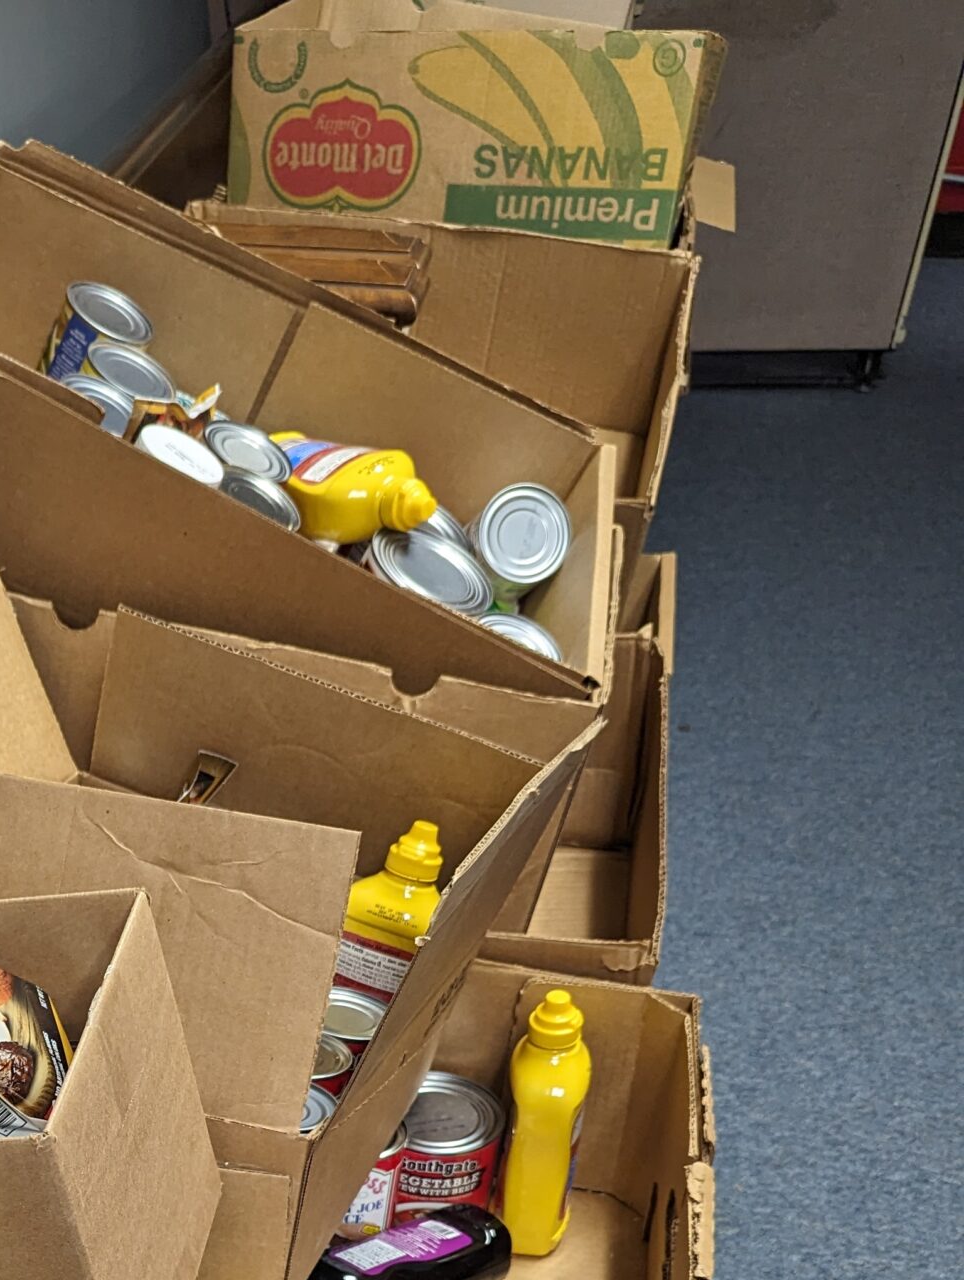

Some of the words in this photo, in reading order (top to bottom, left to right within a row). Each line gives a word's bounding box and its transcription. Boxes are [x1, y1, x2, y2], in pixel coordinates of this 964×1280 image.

[314, 115, 372, 140] Quality
[275, 142, 357, 174] Monte
[363, 142, 405, 175] Del
[473, 144, 670, 182] BANANAS
[496, 192, 660, 230] Premium
[399, 1172, 480, 1188] EGETABLE
[399, 1184, 417, 1193] EW
[451, 1184, 476, 1194] BEEF
[356, 1199, 384, 1213] JOE
